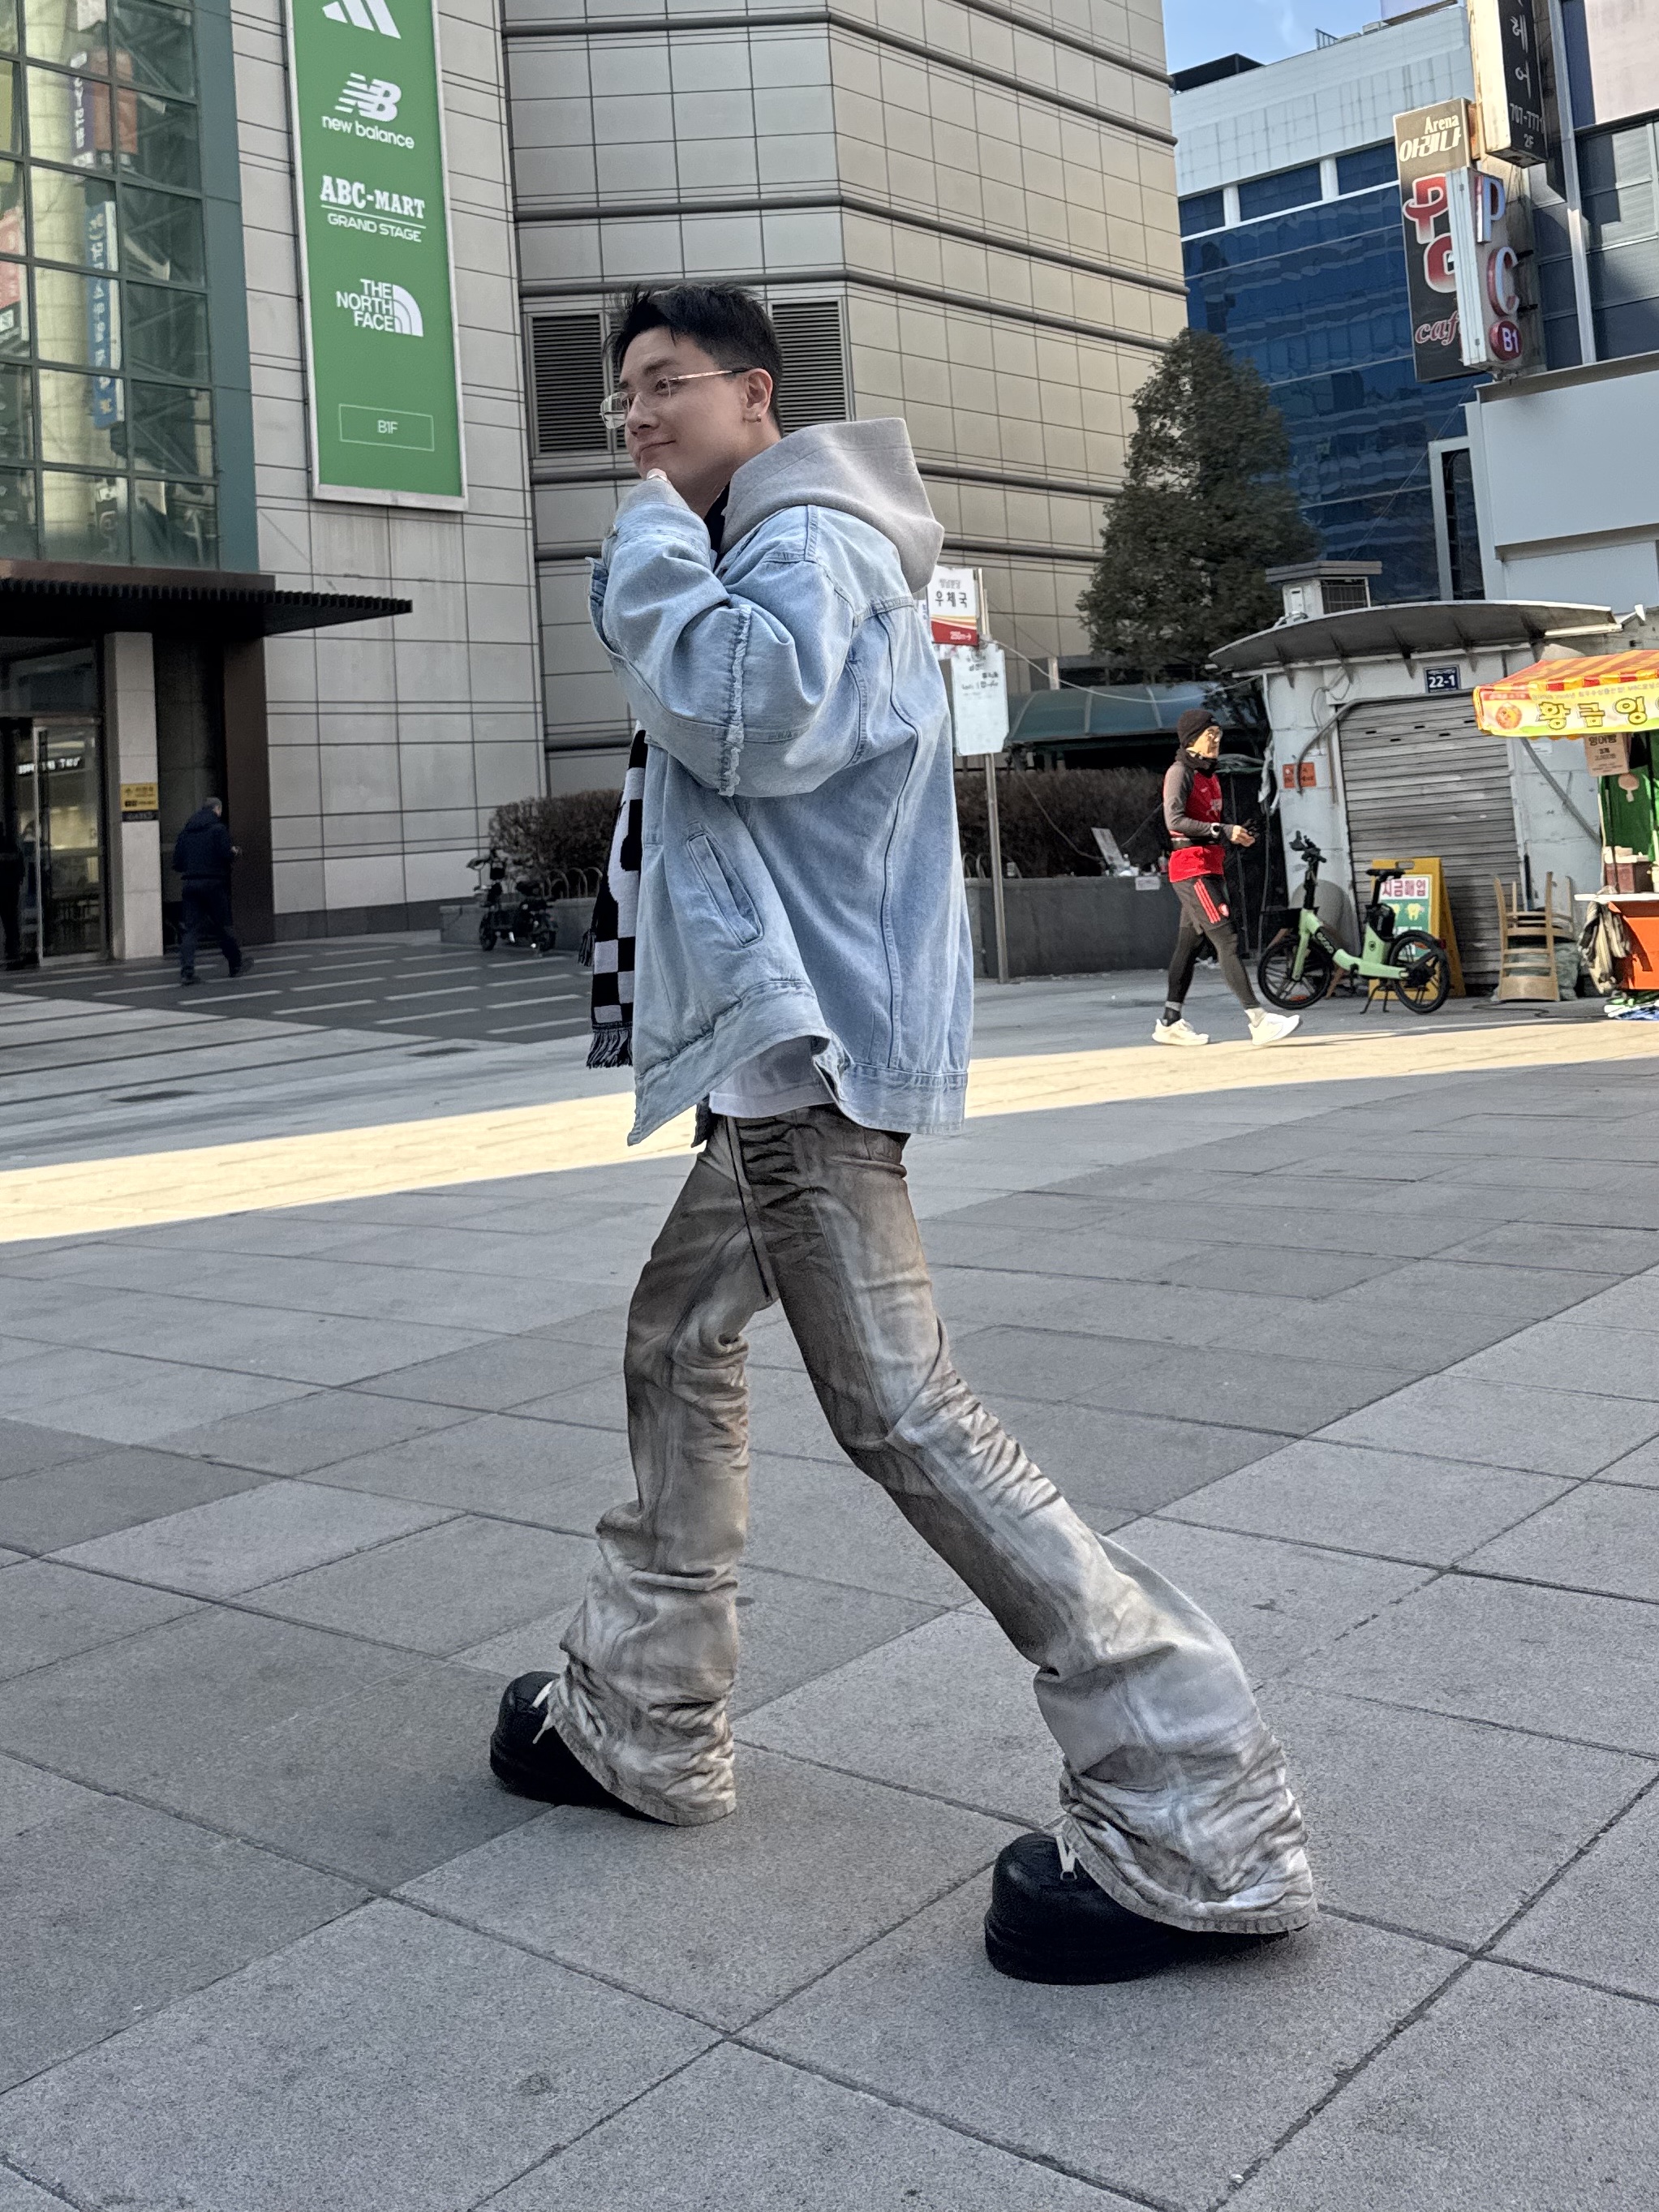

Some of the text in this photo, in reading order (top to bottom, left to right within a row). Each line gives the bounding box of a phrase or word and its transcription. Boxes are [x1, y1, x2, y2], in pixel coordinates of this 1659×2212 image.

[321, 116, 415, 148] new balance
[1425, 115, 1459, 135] Arena
[1399, 127, 1461, 161] 아레나
[320, 174, 425, 219] ABC-MART
[327, 213, 422, 243] GRAND STAGE
[360, 278, 392, 299] THE
[336, 290, 393, 315] NORTH
[354, 311, 394, 333] FACE
[1415, 311, 1460, 346] caf
[1502, 327, 1519, 354] B1
[377, 419, 398, 434] B1F
[935, 591, 967, 608] 우체국
[1428, 675, 1455, 688] 22-1
[1537, 696, 1659, 730] 황금잉
